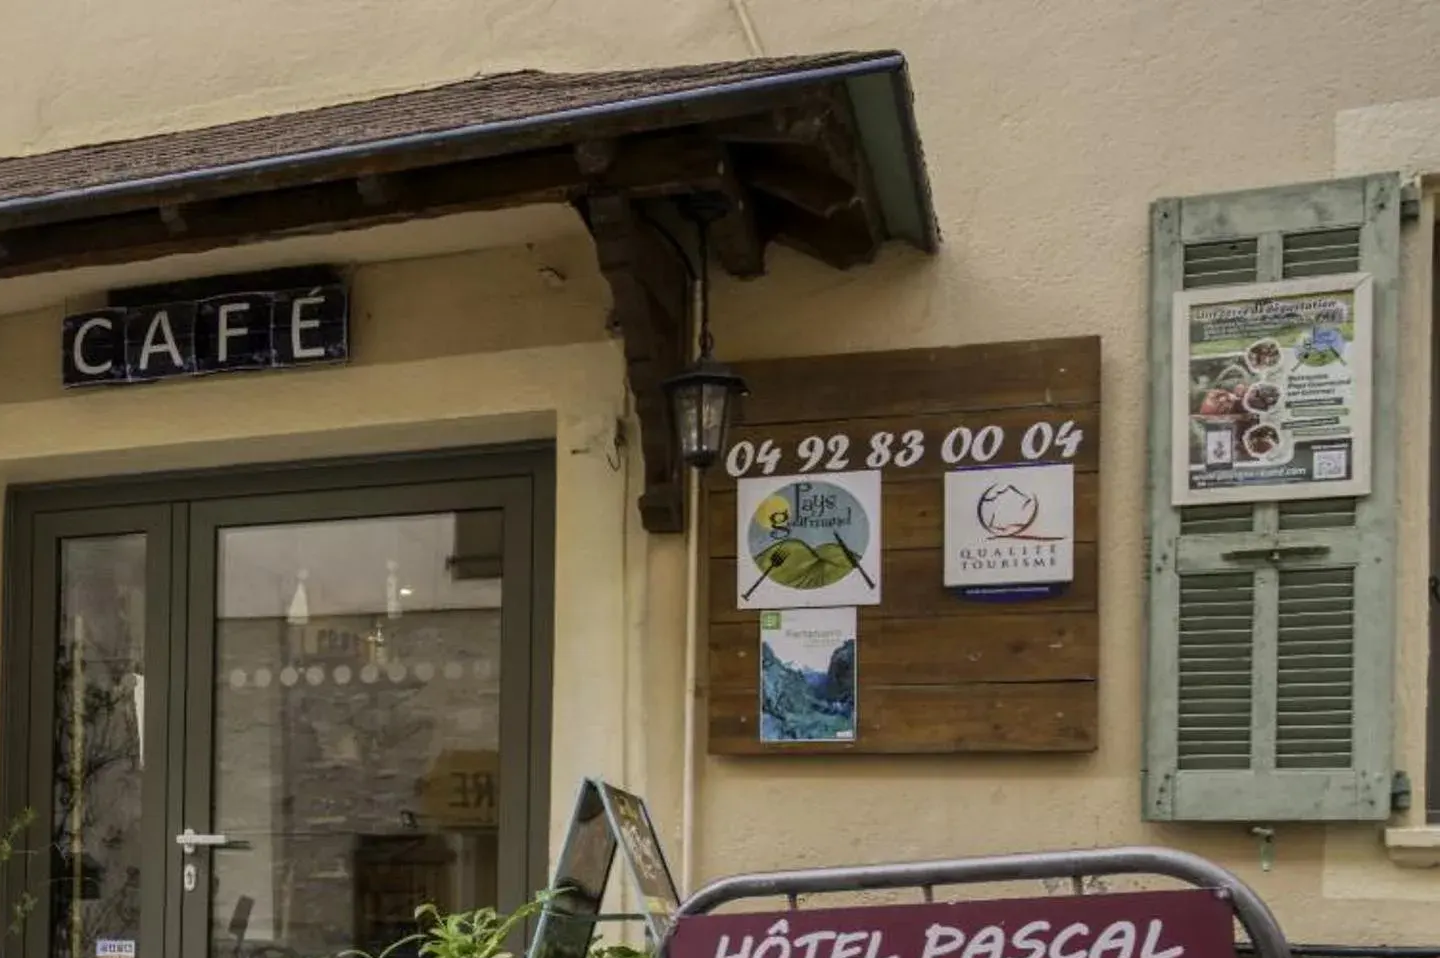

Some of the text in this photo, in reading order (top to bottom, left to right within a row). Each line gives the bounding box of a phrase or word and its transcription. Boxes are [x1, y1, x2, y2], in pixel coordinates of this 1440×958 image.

[73, 286, 326, 375] CAFÉ
[726, 420, 1084, 478] 04 92 83 00 04
[791, 481, 837, 518] Pays
[962, 556, 1057, 571] TOURISME
